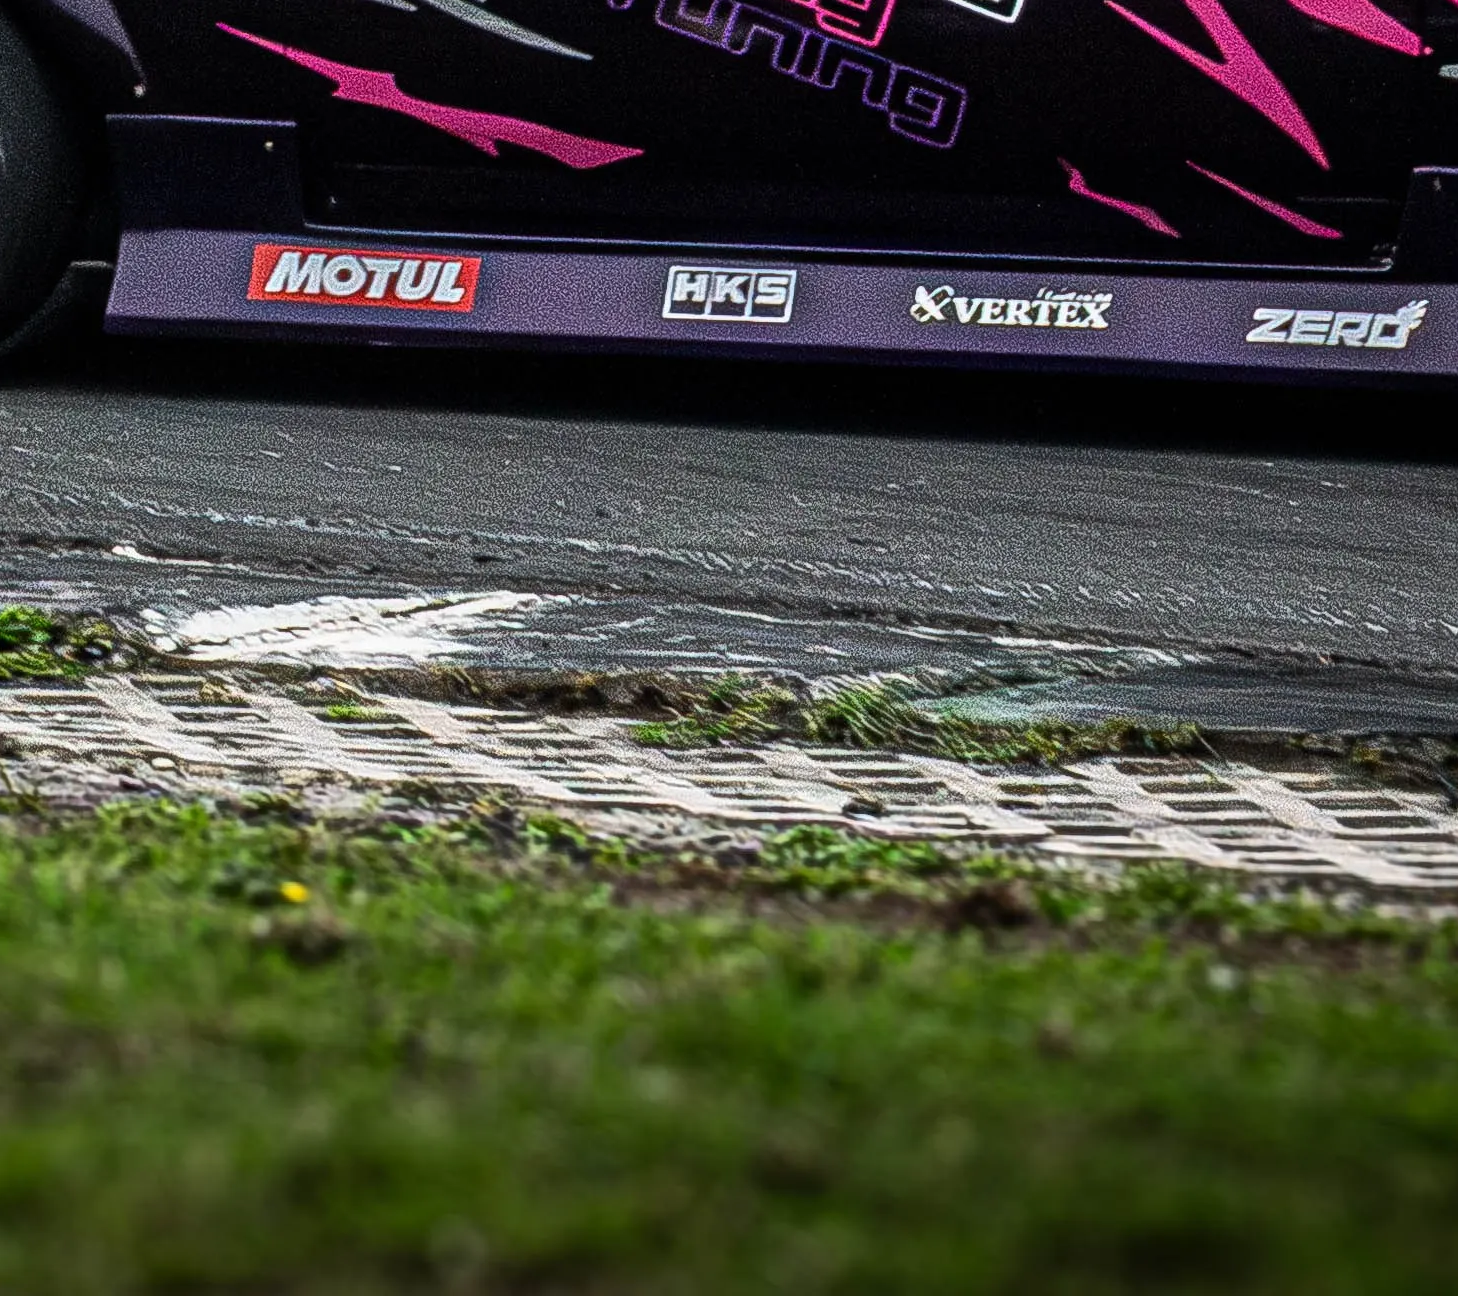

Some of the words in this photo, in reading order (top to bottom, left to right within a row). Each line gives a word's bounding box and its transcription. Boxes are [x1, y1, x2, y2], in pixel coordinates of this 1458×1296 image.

[265, 251, 467, 303] MOTUL
[673, 270, 788, 305] HKS
[953, 297, 1112, 330] VERTEX
[1245, 306, 1409, 349] ZERO
